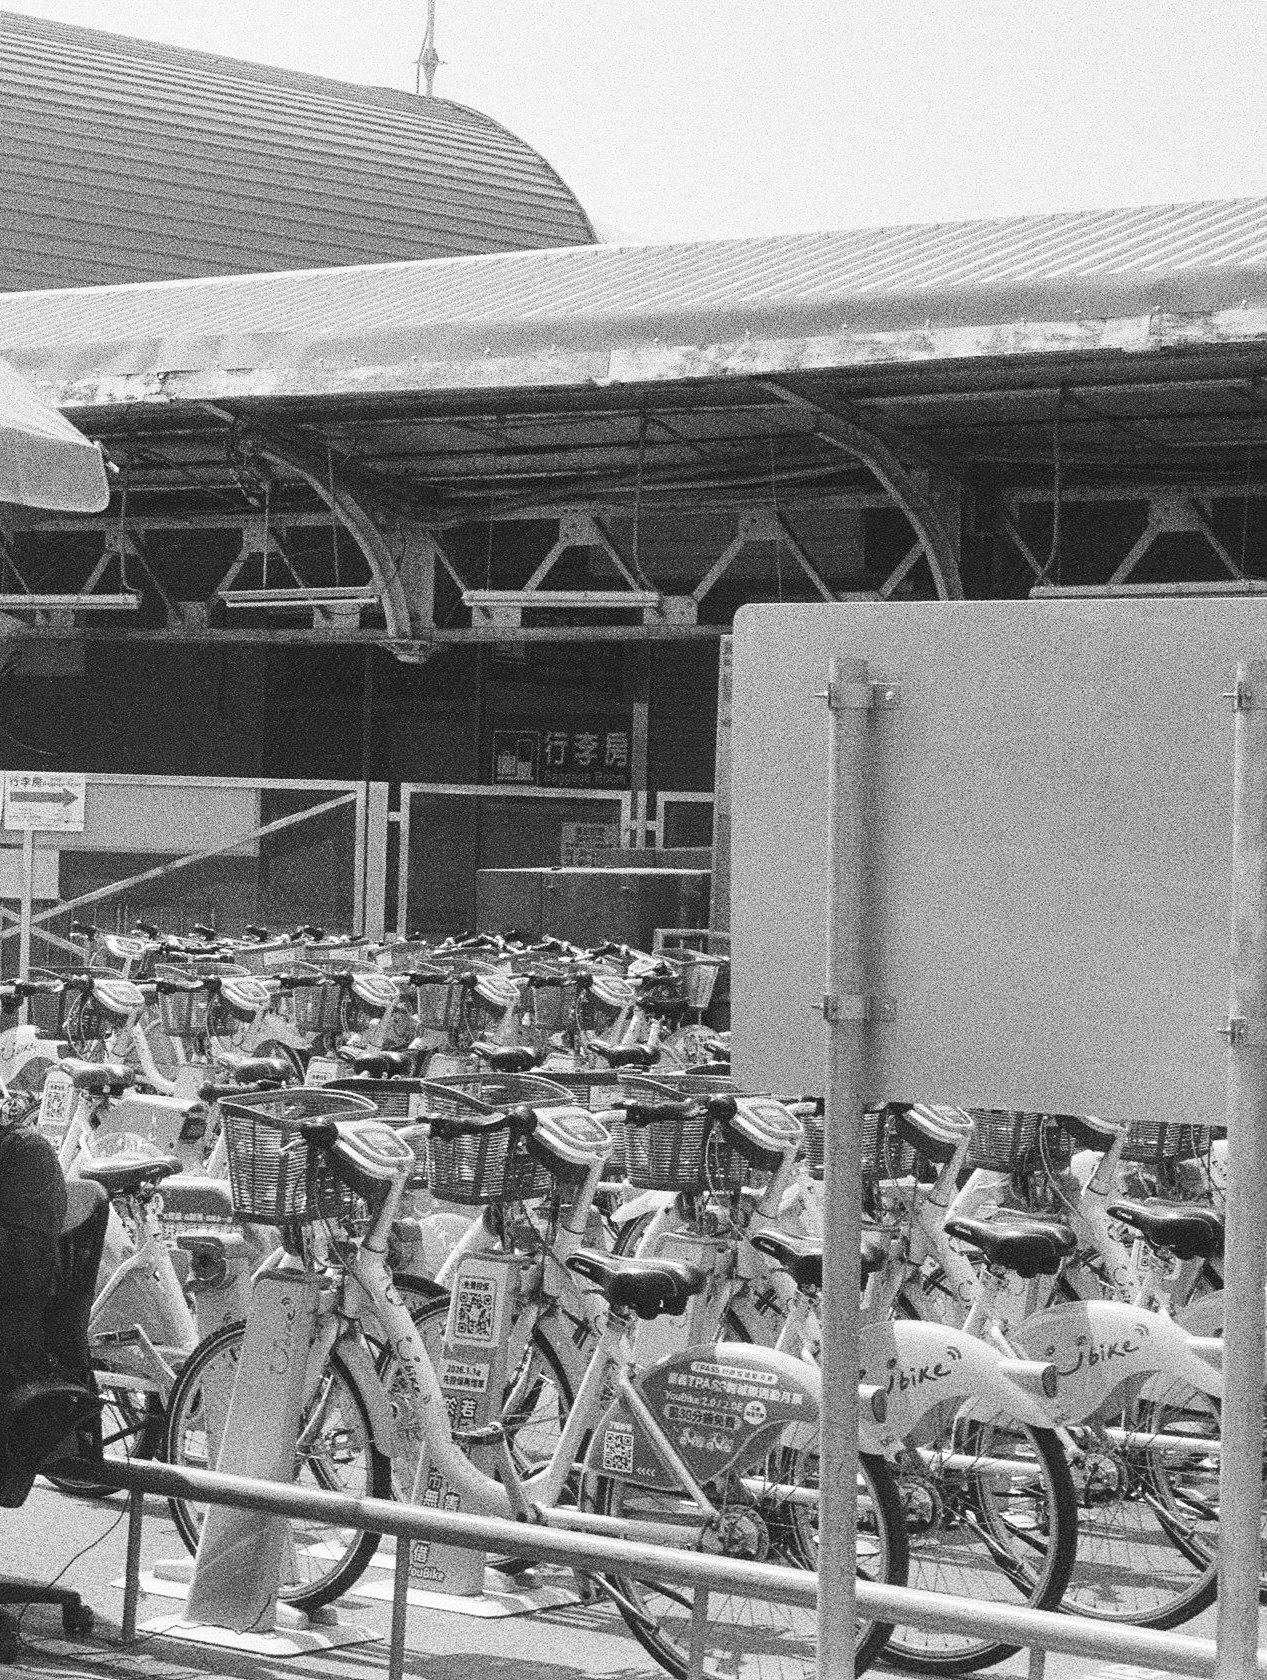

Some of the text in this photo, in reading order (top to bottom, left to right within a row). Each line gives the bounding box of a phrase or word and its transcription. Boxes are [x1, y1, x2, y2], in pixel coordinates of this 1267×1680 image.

[544, 731, 628, 767] 行李房
[544, 770, 627, 786] Baggage Room
[664, 1390, 700, 1404] YouBike
